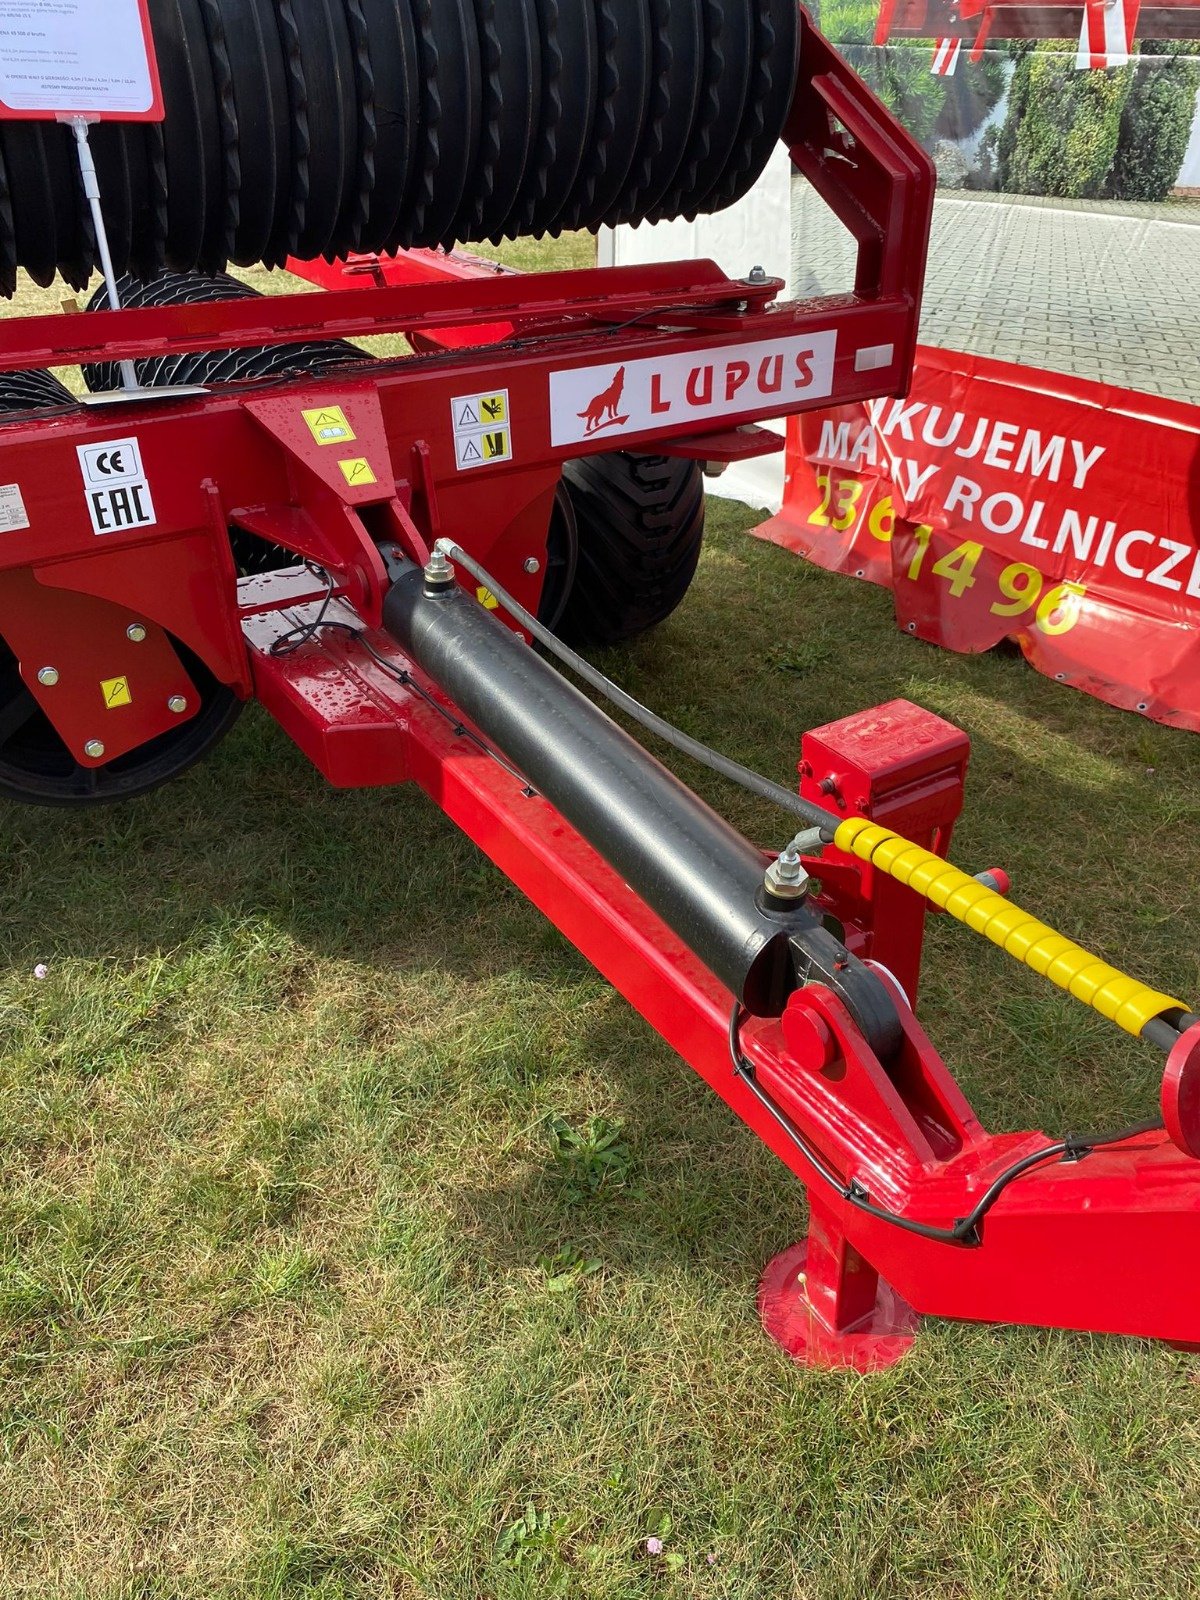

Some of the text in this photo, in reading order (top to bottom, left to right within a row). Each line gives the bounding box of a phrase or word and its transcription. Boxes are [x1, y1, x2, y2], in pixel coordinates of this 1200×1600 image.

[650, 349, 815, 414] LUPUS
[96, 450, 125, 474] CE
[91, 484, 150, 530] EAC
[807, 475, 863, 532] 23
[907, 523, 986, 599] 14
[990, 561, 1087, 637] 96
